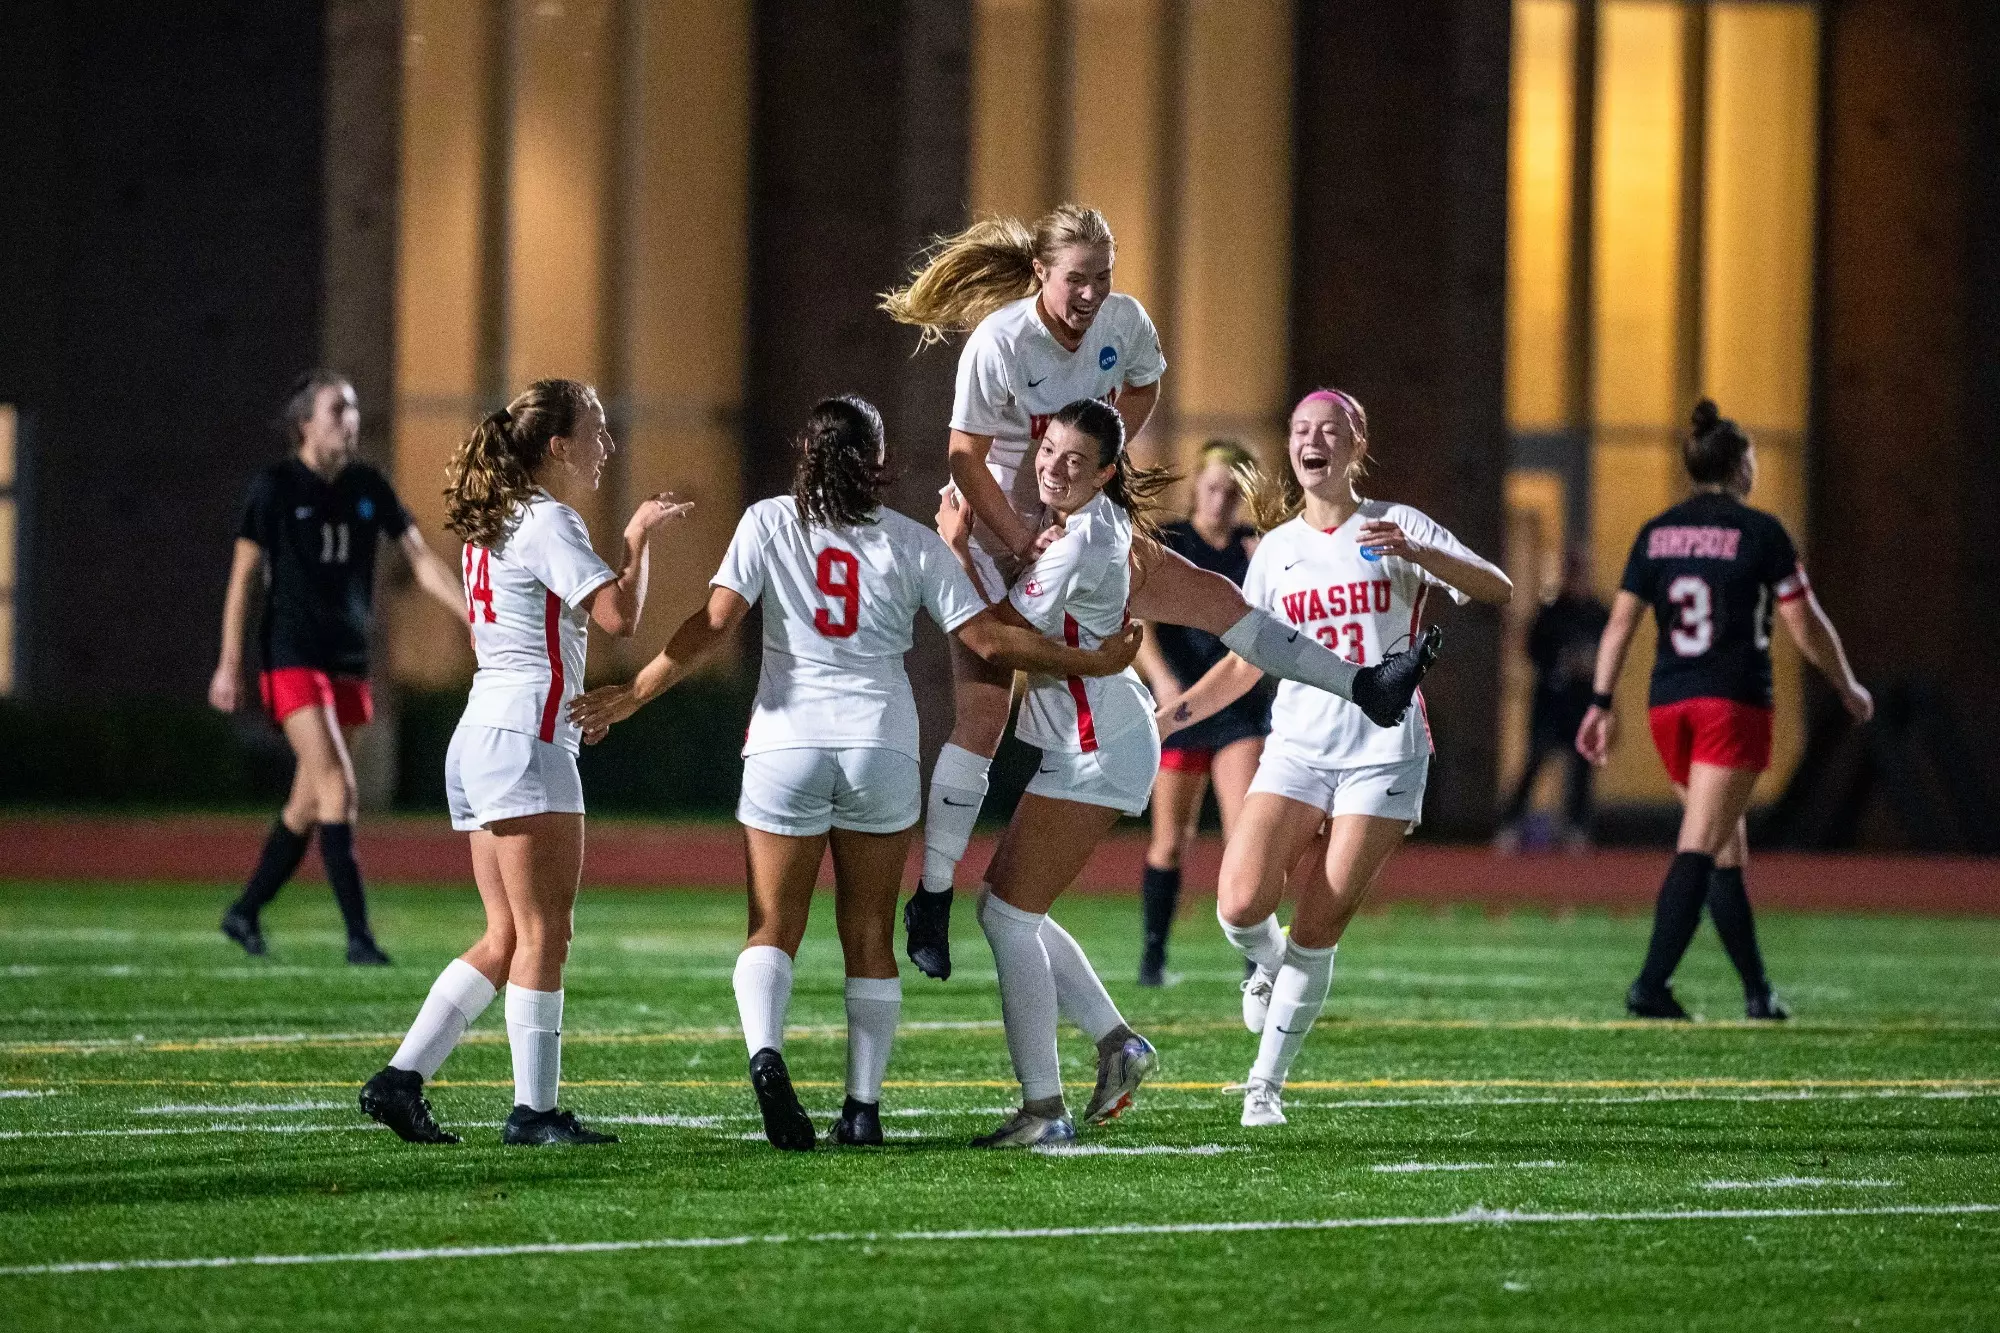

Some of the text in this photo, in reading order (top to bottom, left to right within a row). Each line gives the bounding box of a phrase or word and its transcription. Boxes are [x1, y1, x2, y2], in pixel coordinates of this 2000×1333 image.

[321, 522, 349, 563] 11
[815, 547, 859, 638] 9
[1282, 579, 1392, 625] WASHU
[1669, 576, 1712, 657] 3
